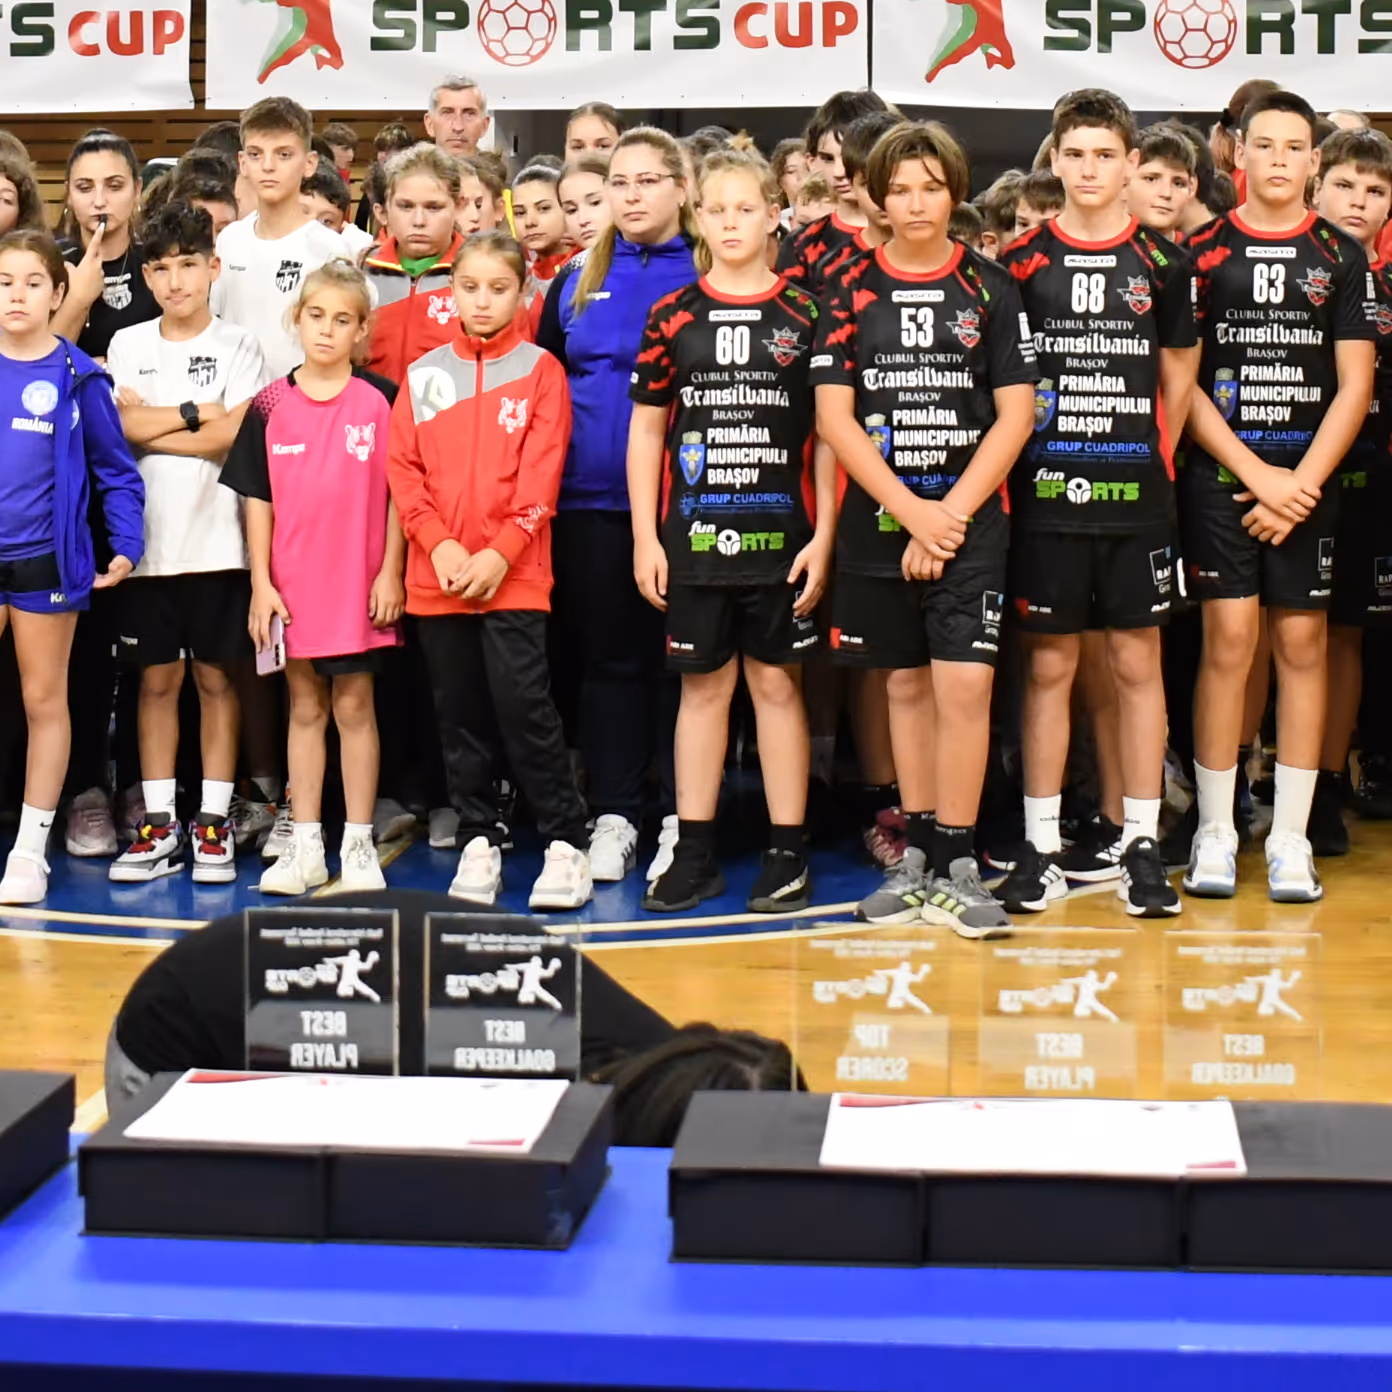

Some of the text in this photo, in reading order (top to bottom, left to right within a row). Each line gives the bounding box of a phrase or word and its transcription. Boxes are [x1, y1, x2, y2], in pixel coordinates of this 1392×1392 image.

[67, 9, 185, 56] CUP
[733, 0, 859, 49] CUP
[1071, 272, 1107, 314] 68
[1253, 262, 1287, 304] 63
[1043, 317, 1135, 331] CLUBUL SPORTIV
[1225, 308, 1311, 321] CLUBUL SPORTIV
[900, 306, 935, 348] 53
[1215, 322, 1324, 345] Transilvania
[1032, 331, 1150, 356] Transilvania
[874, 352, 965, 365] CLUBUL SPORTIV
[690, 368, 779, 383] CLUBUL SPORTIV
[1058, 372, 1126, 393] PRIMĂRIA
[1240, 363, 1305, 382] PRIMĂRIA
[680, 383, 790, 408] Transilvania
[1057, 395, 1152, 414] MUNICIPIULUI
[892, 405, 958, 426] PRIMĂRIA
[1240, 405, 1292, 427] BRAȘOV
[707, 424, 771, 444] PRIMĂRIA
[1056, 415, 1113, 438] BRAȘOV
[1046, 440, 1151, 454] GRUP CUADRIPOL
[894, 449, 948, 471] BRAȘOV
[707, 467, 760, 490] BRAȘOV
[1033, 466, 1066, 482] fun
[699, 493, 730, 505] GRUP
